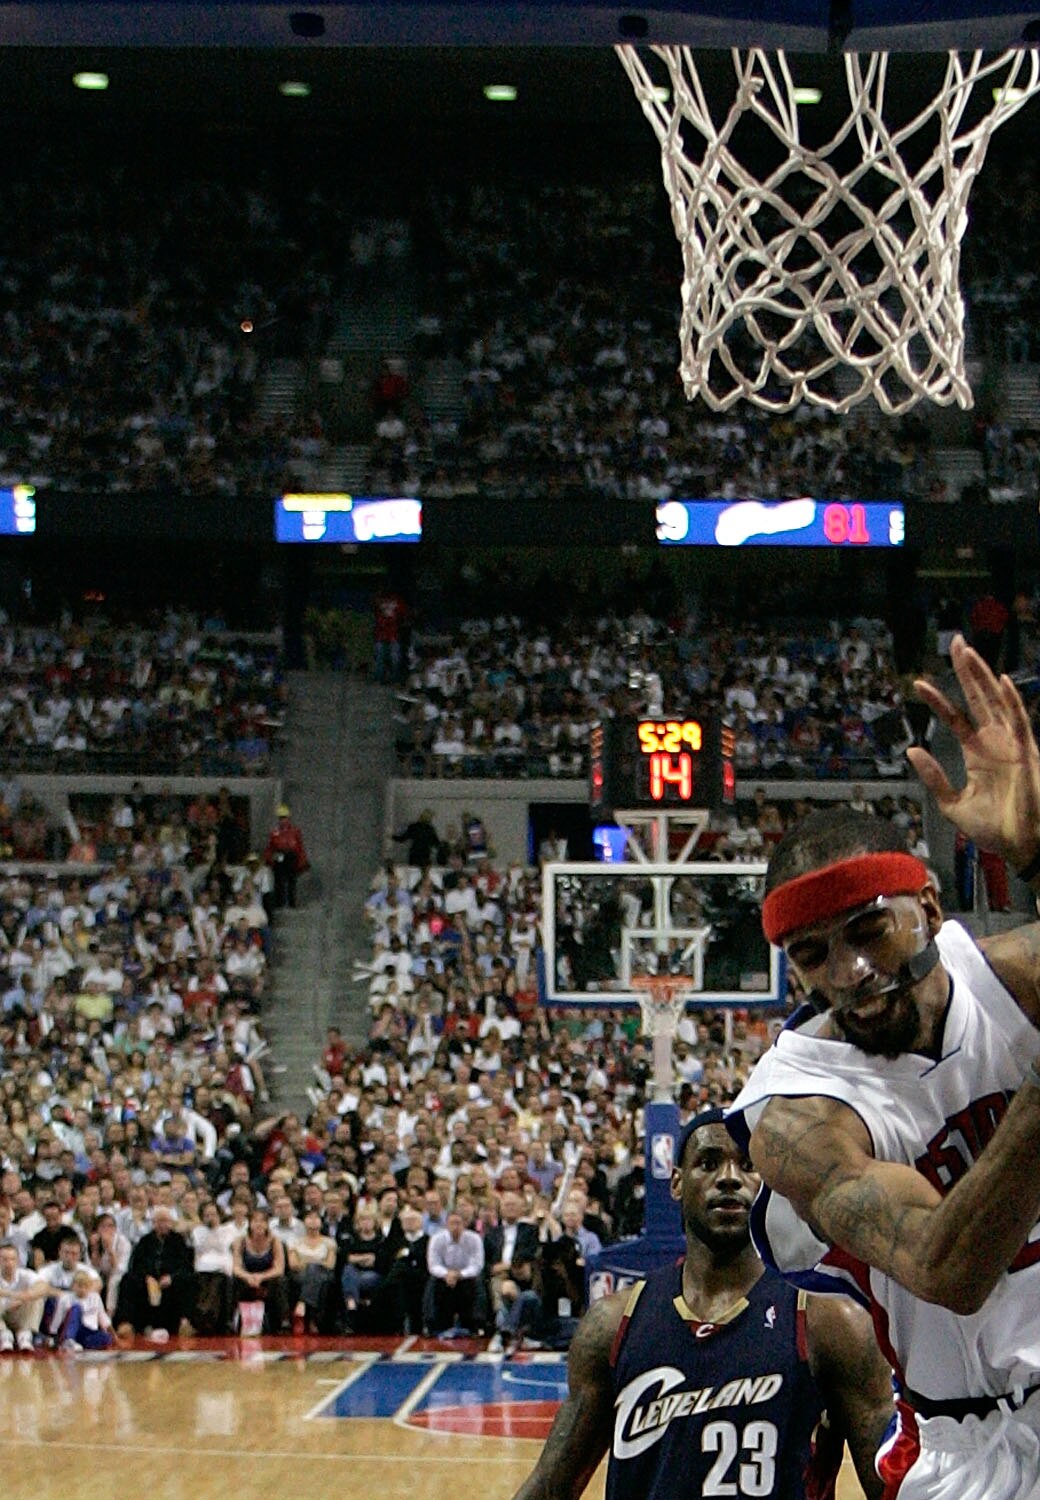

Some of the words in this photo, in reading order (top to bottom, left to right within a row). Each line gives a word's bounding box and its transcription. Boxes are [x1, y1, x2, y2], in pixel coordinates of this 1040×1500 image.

[824, 503, 869, 543] 81
[638, 721, 702, 753] 5:29
[650, 752, 692, 800] 14
[702, 1421, 778, 1497] 23
